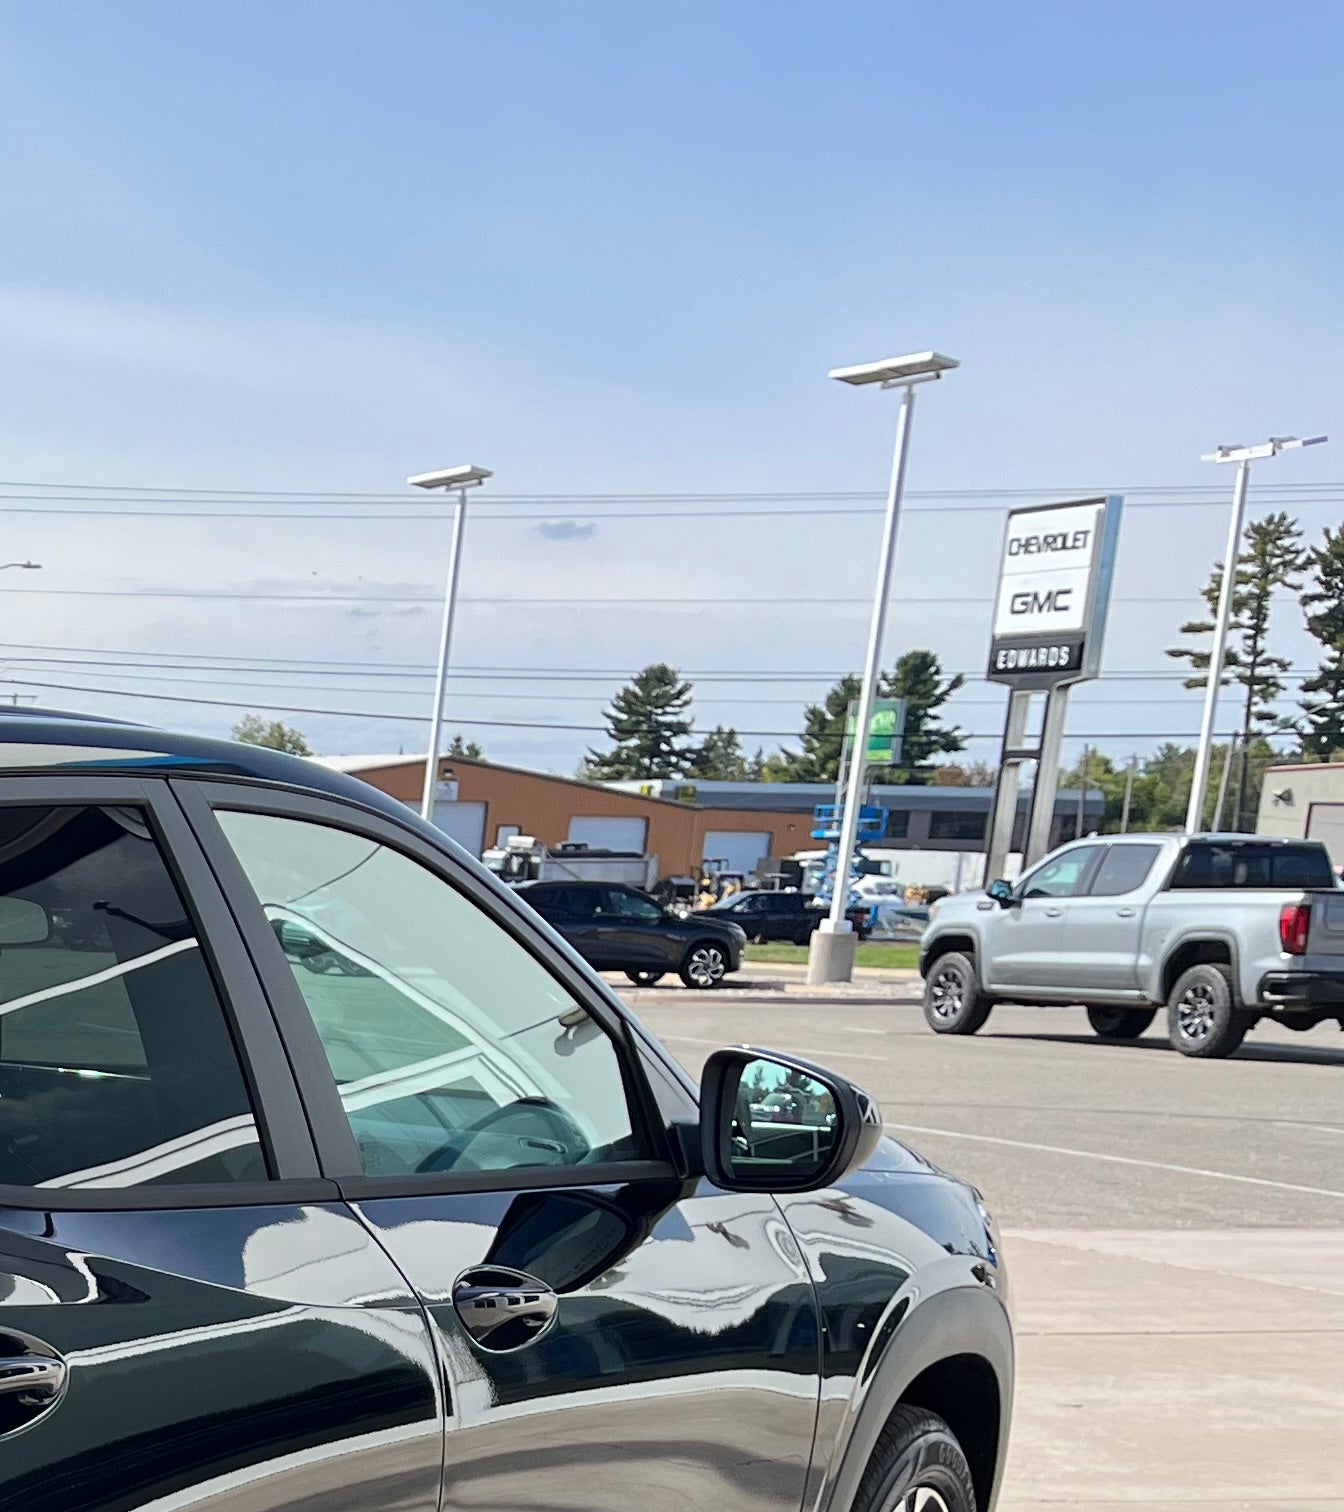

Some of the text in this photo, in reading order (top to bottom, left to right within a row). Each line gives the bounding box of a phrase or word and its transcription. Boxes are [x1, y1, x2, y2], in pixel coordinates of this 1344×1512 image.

[1008, 529, 1091, 556] CHEVROLET
[1010, 588, 1073, 615] GMC
[996, 645, 1070, 669] EDWARDS
